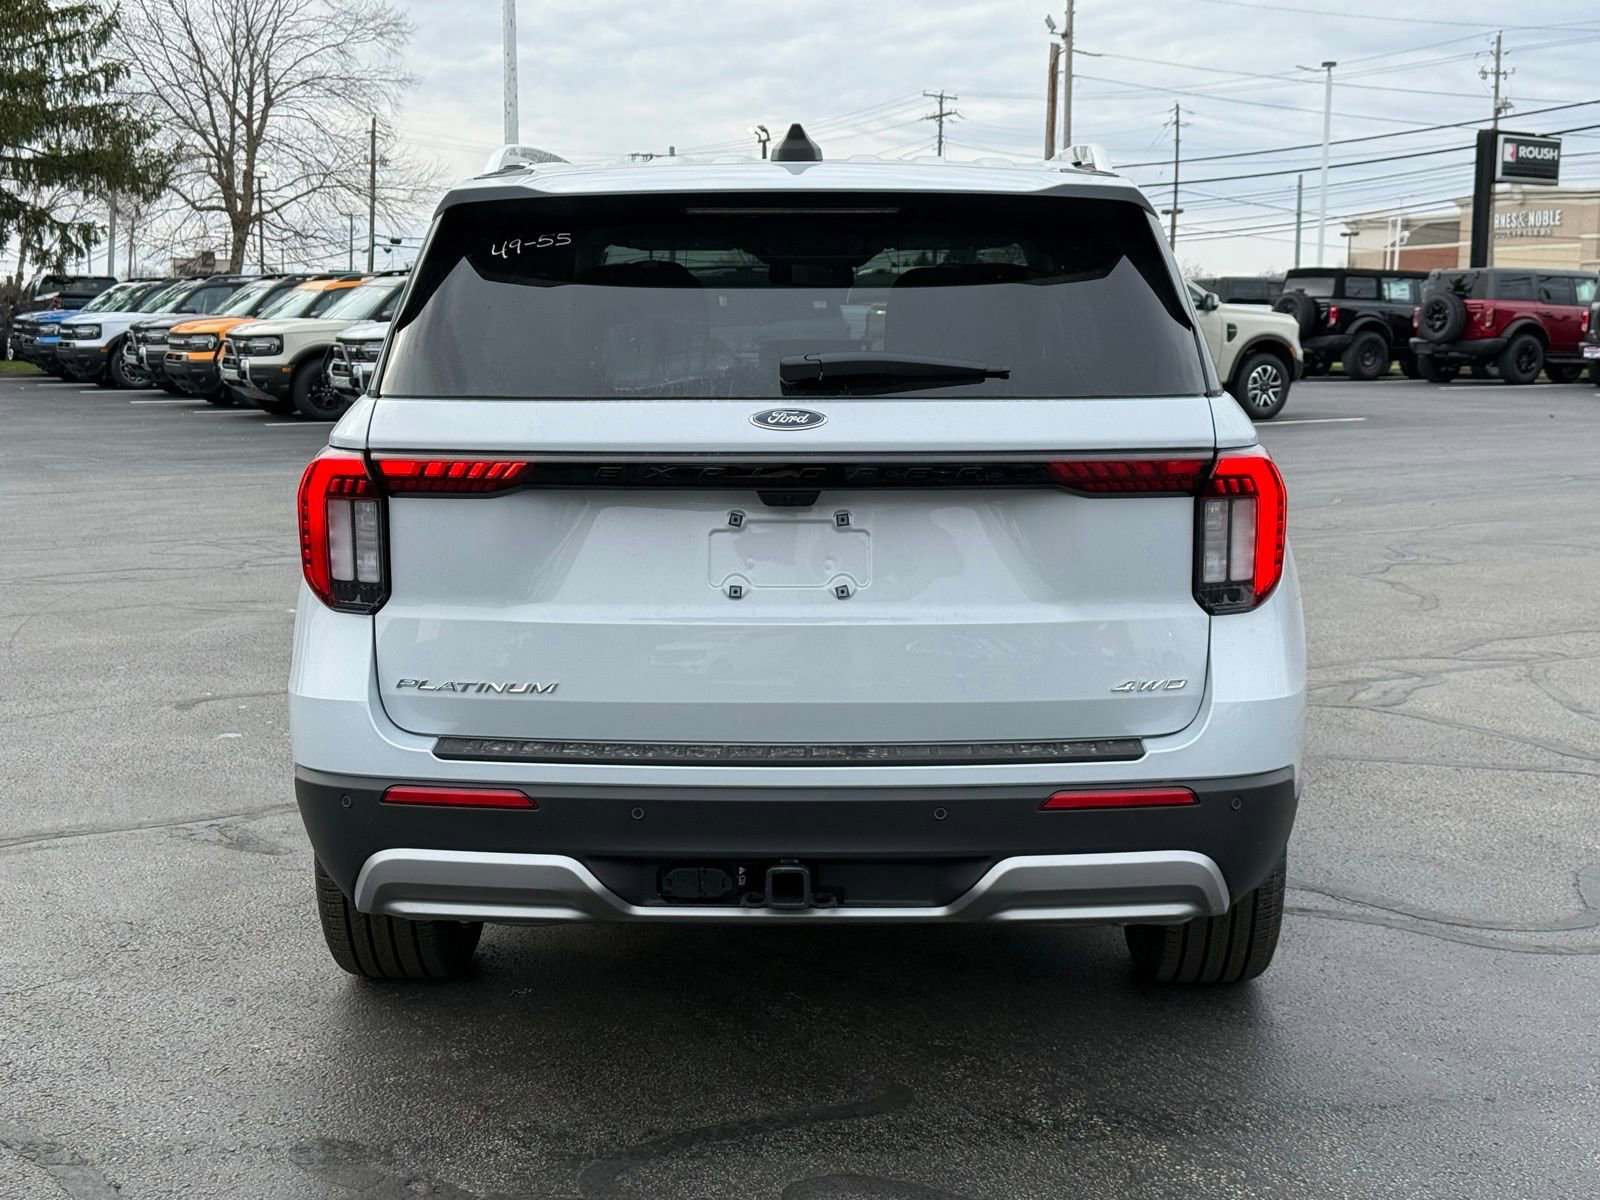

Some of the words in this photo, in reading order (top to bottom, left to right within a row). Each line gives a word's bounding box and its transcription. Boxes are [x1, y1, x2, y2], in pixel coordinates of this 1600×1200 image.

[1518, 145, 1558, 160] ROUSH
[1495, 212, 1518, 228] RNES
[1528, 209, 1562, 226] NOBLE
[491, 232, 572, 259] 49-55
[767, 410, 810, 424] Ford
[395, 678, 560, 694] PLATINUM
[1111, 678, 1187, 693] 4WD
